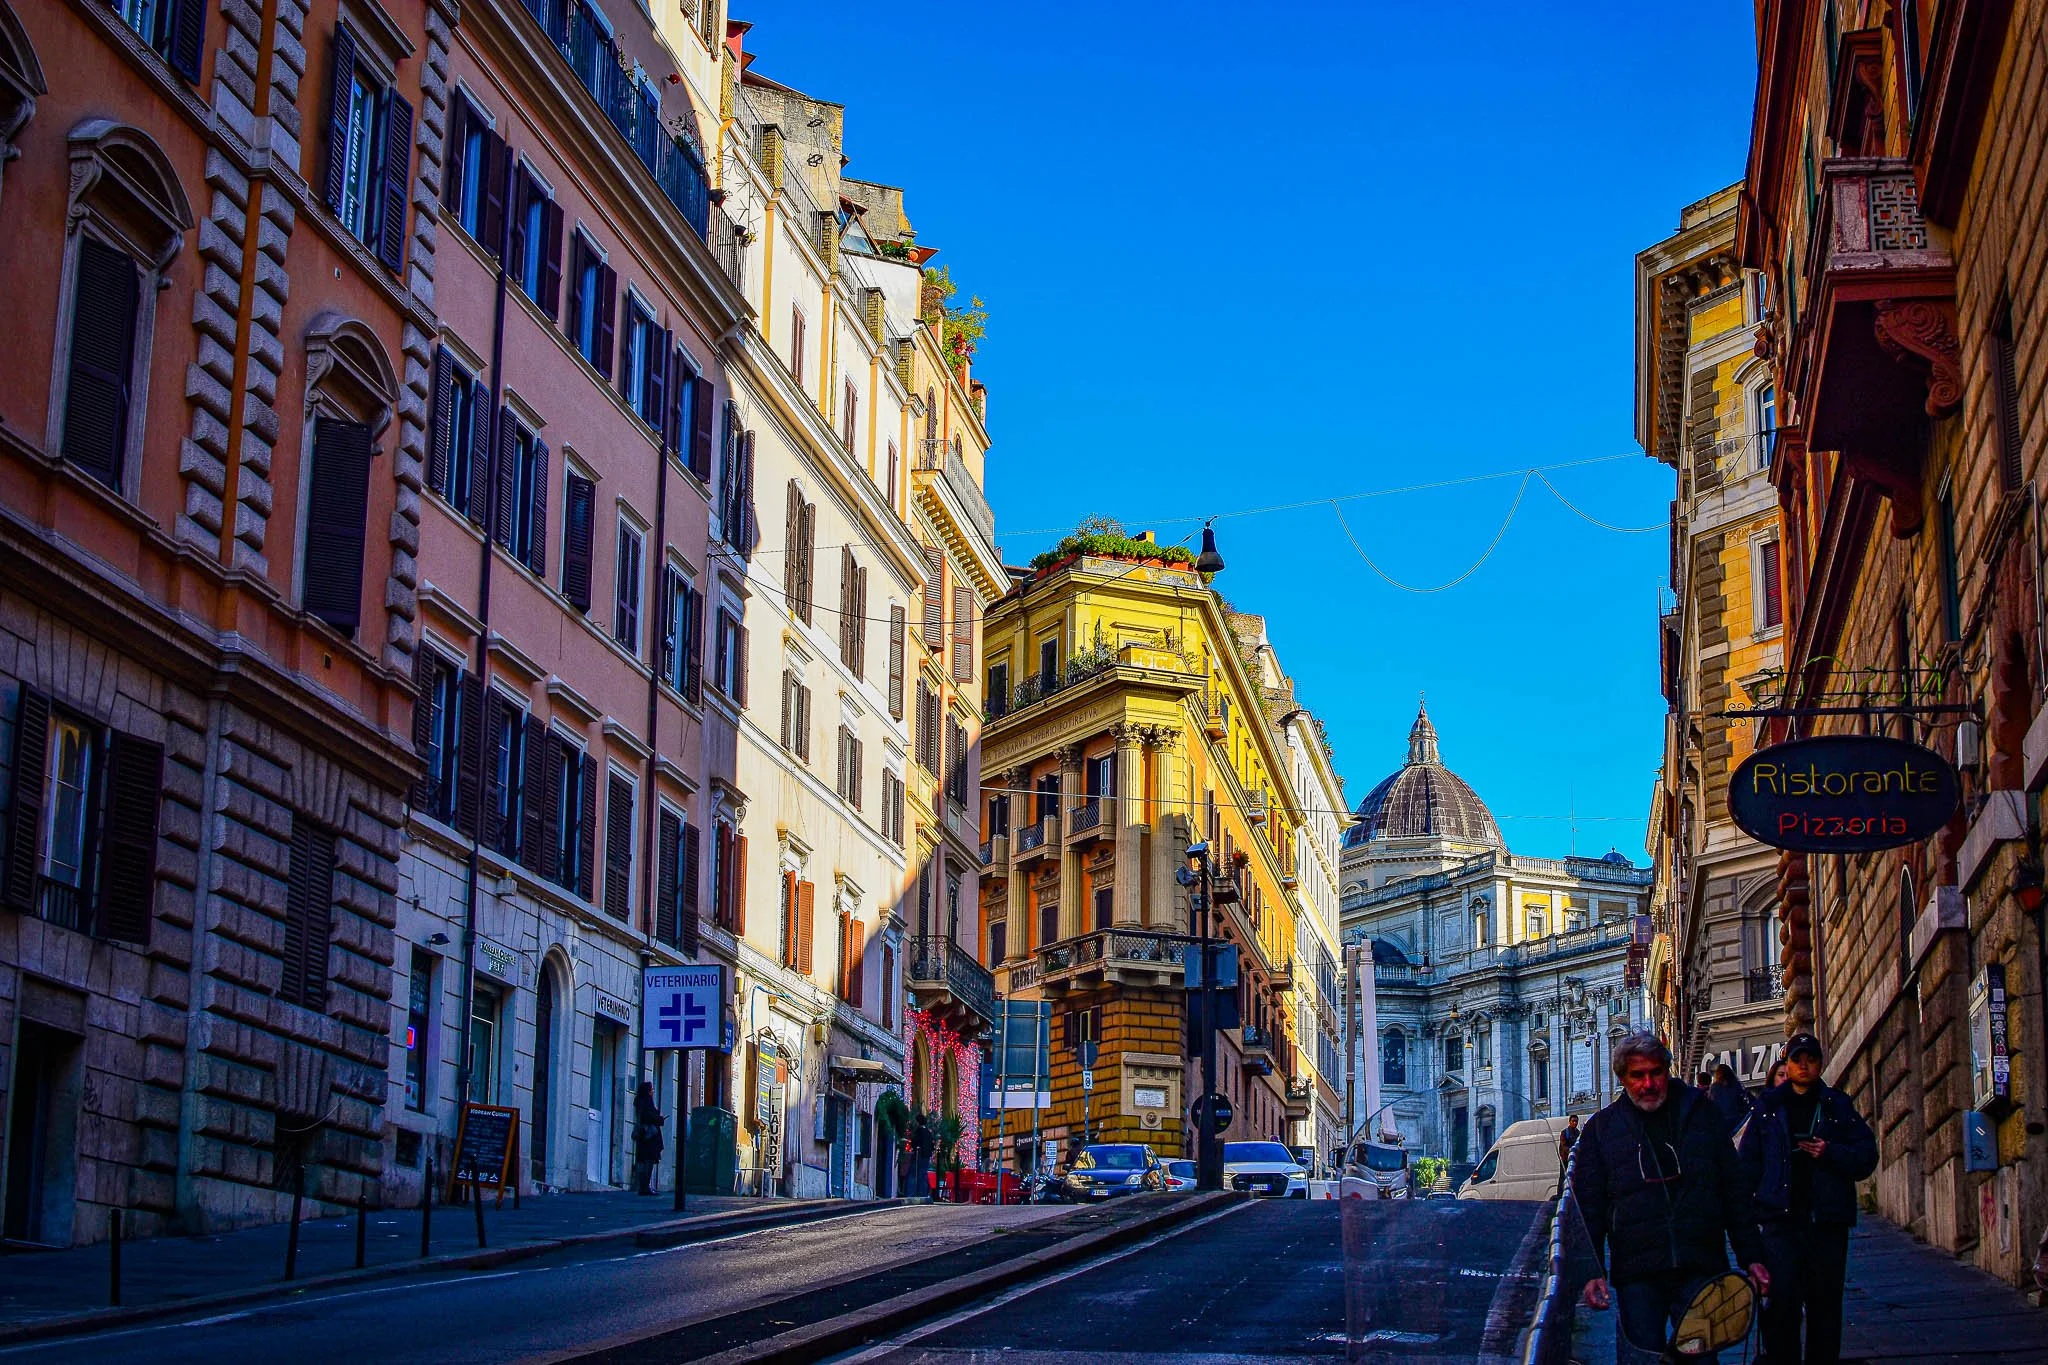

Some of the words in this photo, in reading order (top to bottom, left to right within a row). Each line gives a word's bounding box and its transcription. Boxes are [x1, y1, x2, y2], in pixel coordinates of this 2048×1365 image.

[1030, 725, 1057, 744] IMPERIO
[1753, 761, 1937, 796] Ristorante
[1779, 811, 1908, 836] Pizzeria
[646, 973, 719, 988] VETERINARIO
[597, 994, 630, 1021] VETERINARIO
[769, 1104, 778, 1176] LAUNDRY
